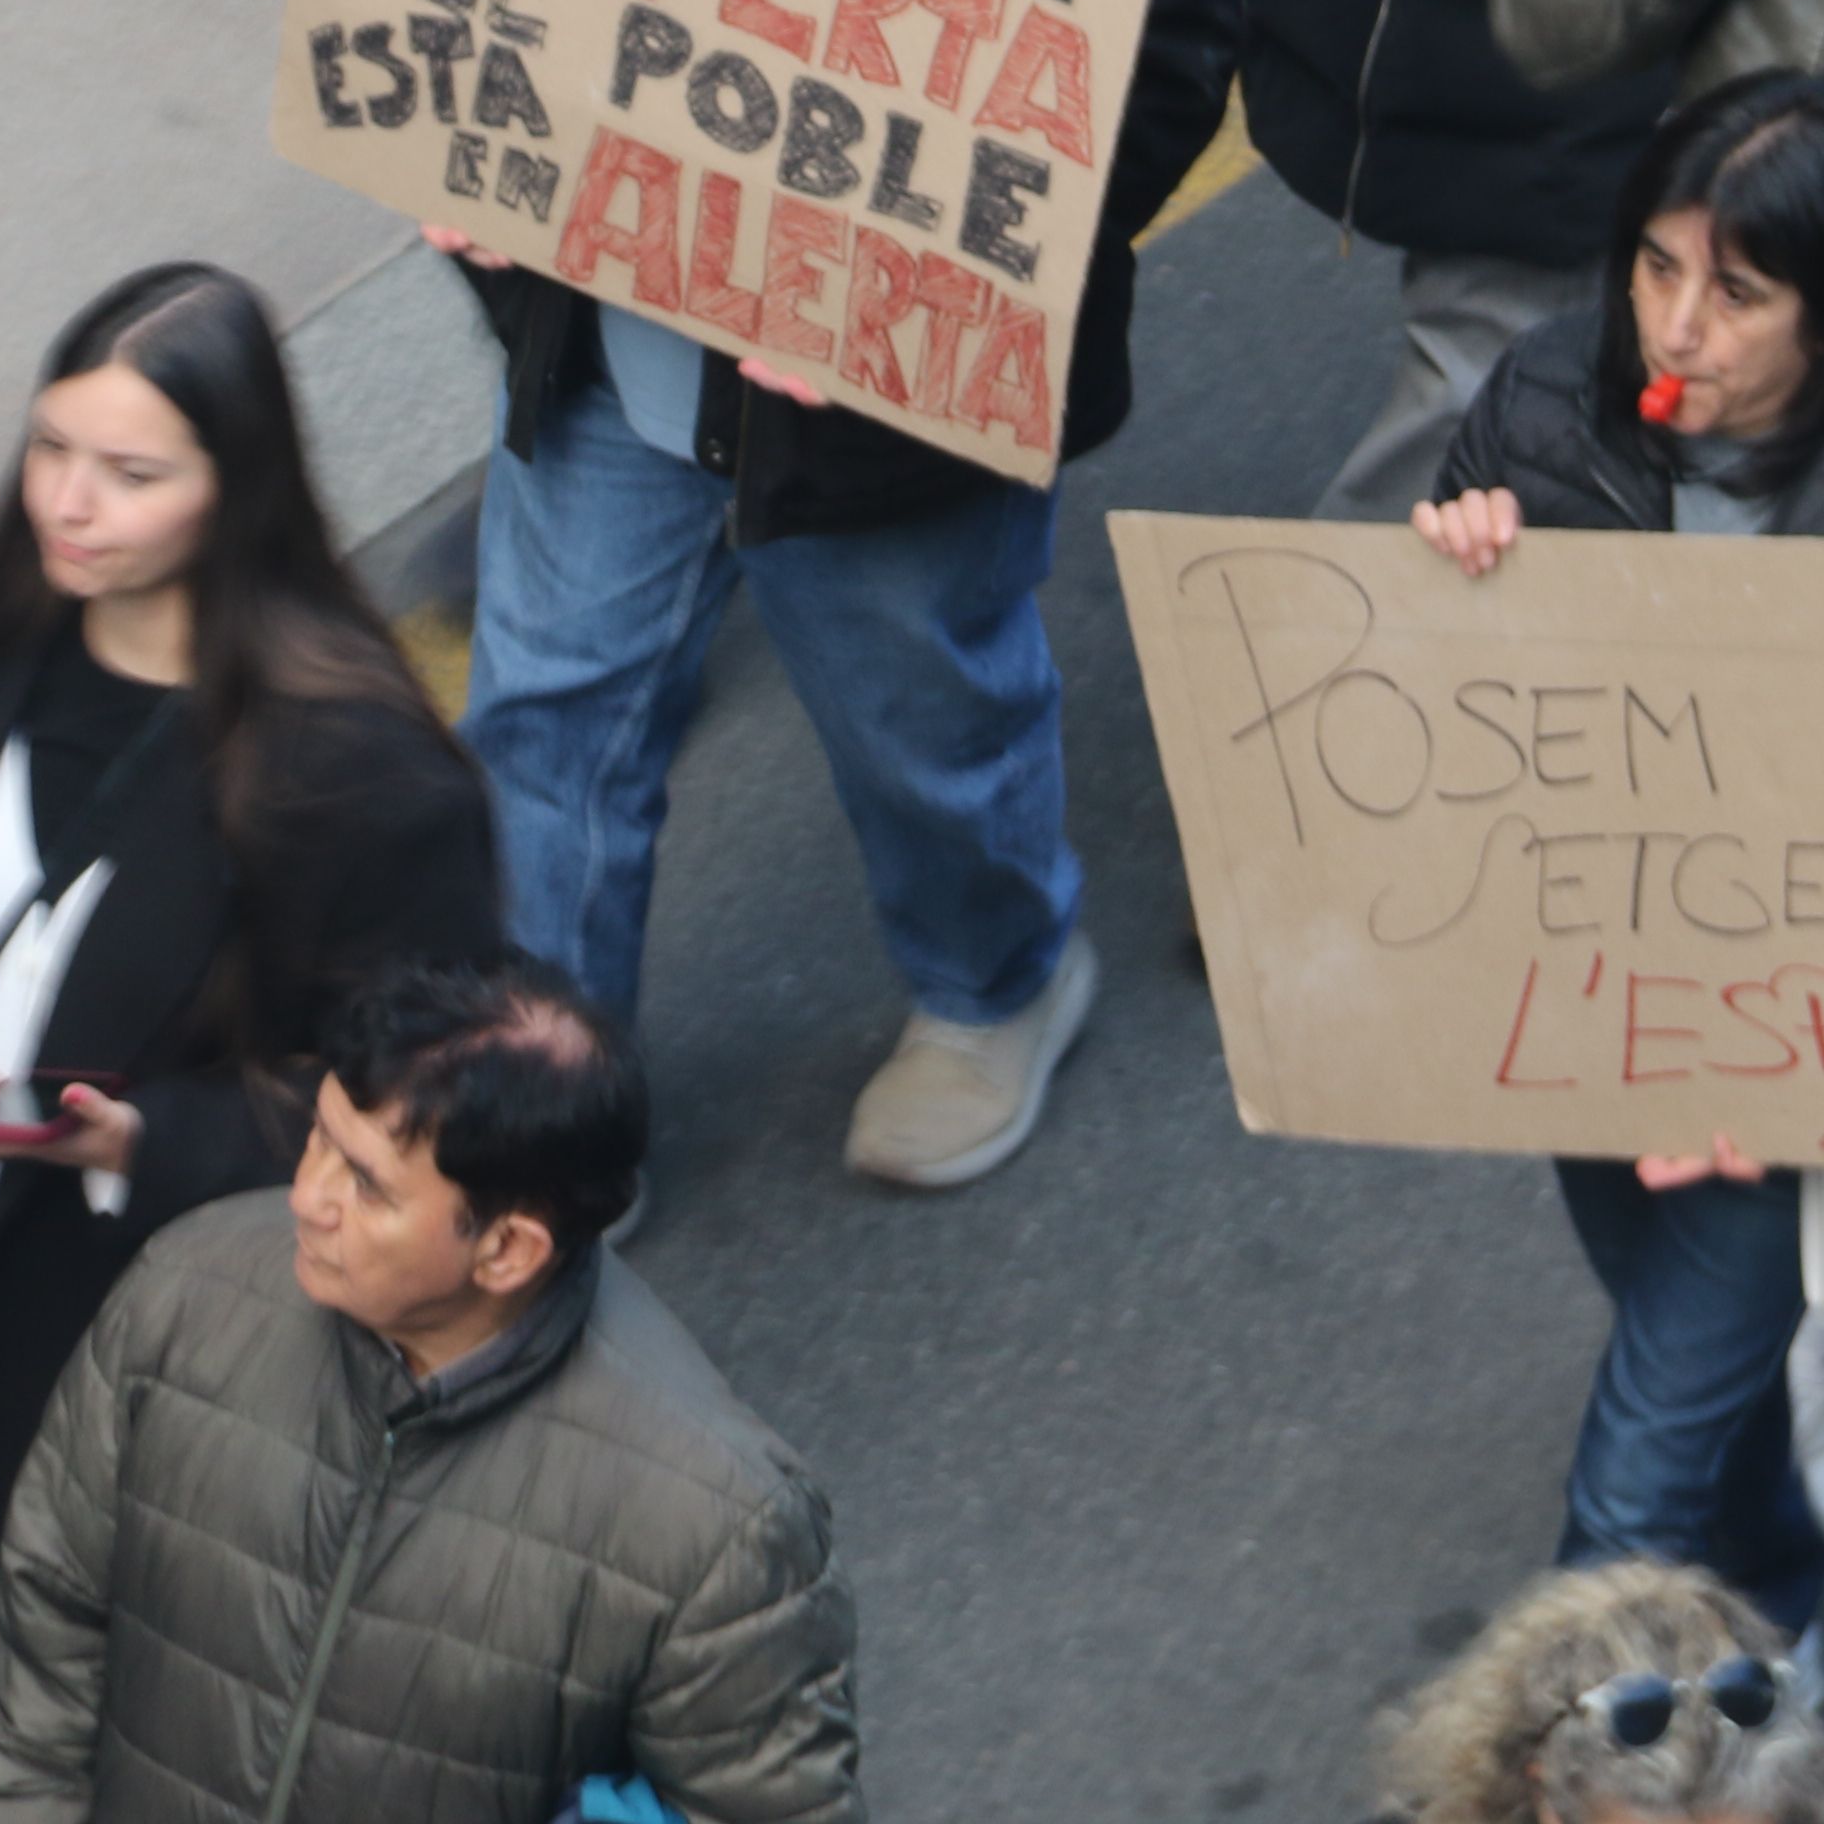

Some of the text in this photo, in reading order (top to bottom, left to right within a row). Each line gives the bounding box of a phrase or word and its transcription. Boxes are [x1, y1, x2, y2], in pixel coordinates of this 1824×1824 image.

[444, 125, 1054, 456] EN ALERTA
[609, 4, 1053, 284] POBLE
[1177, 547, 1718, 848] POSEM
